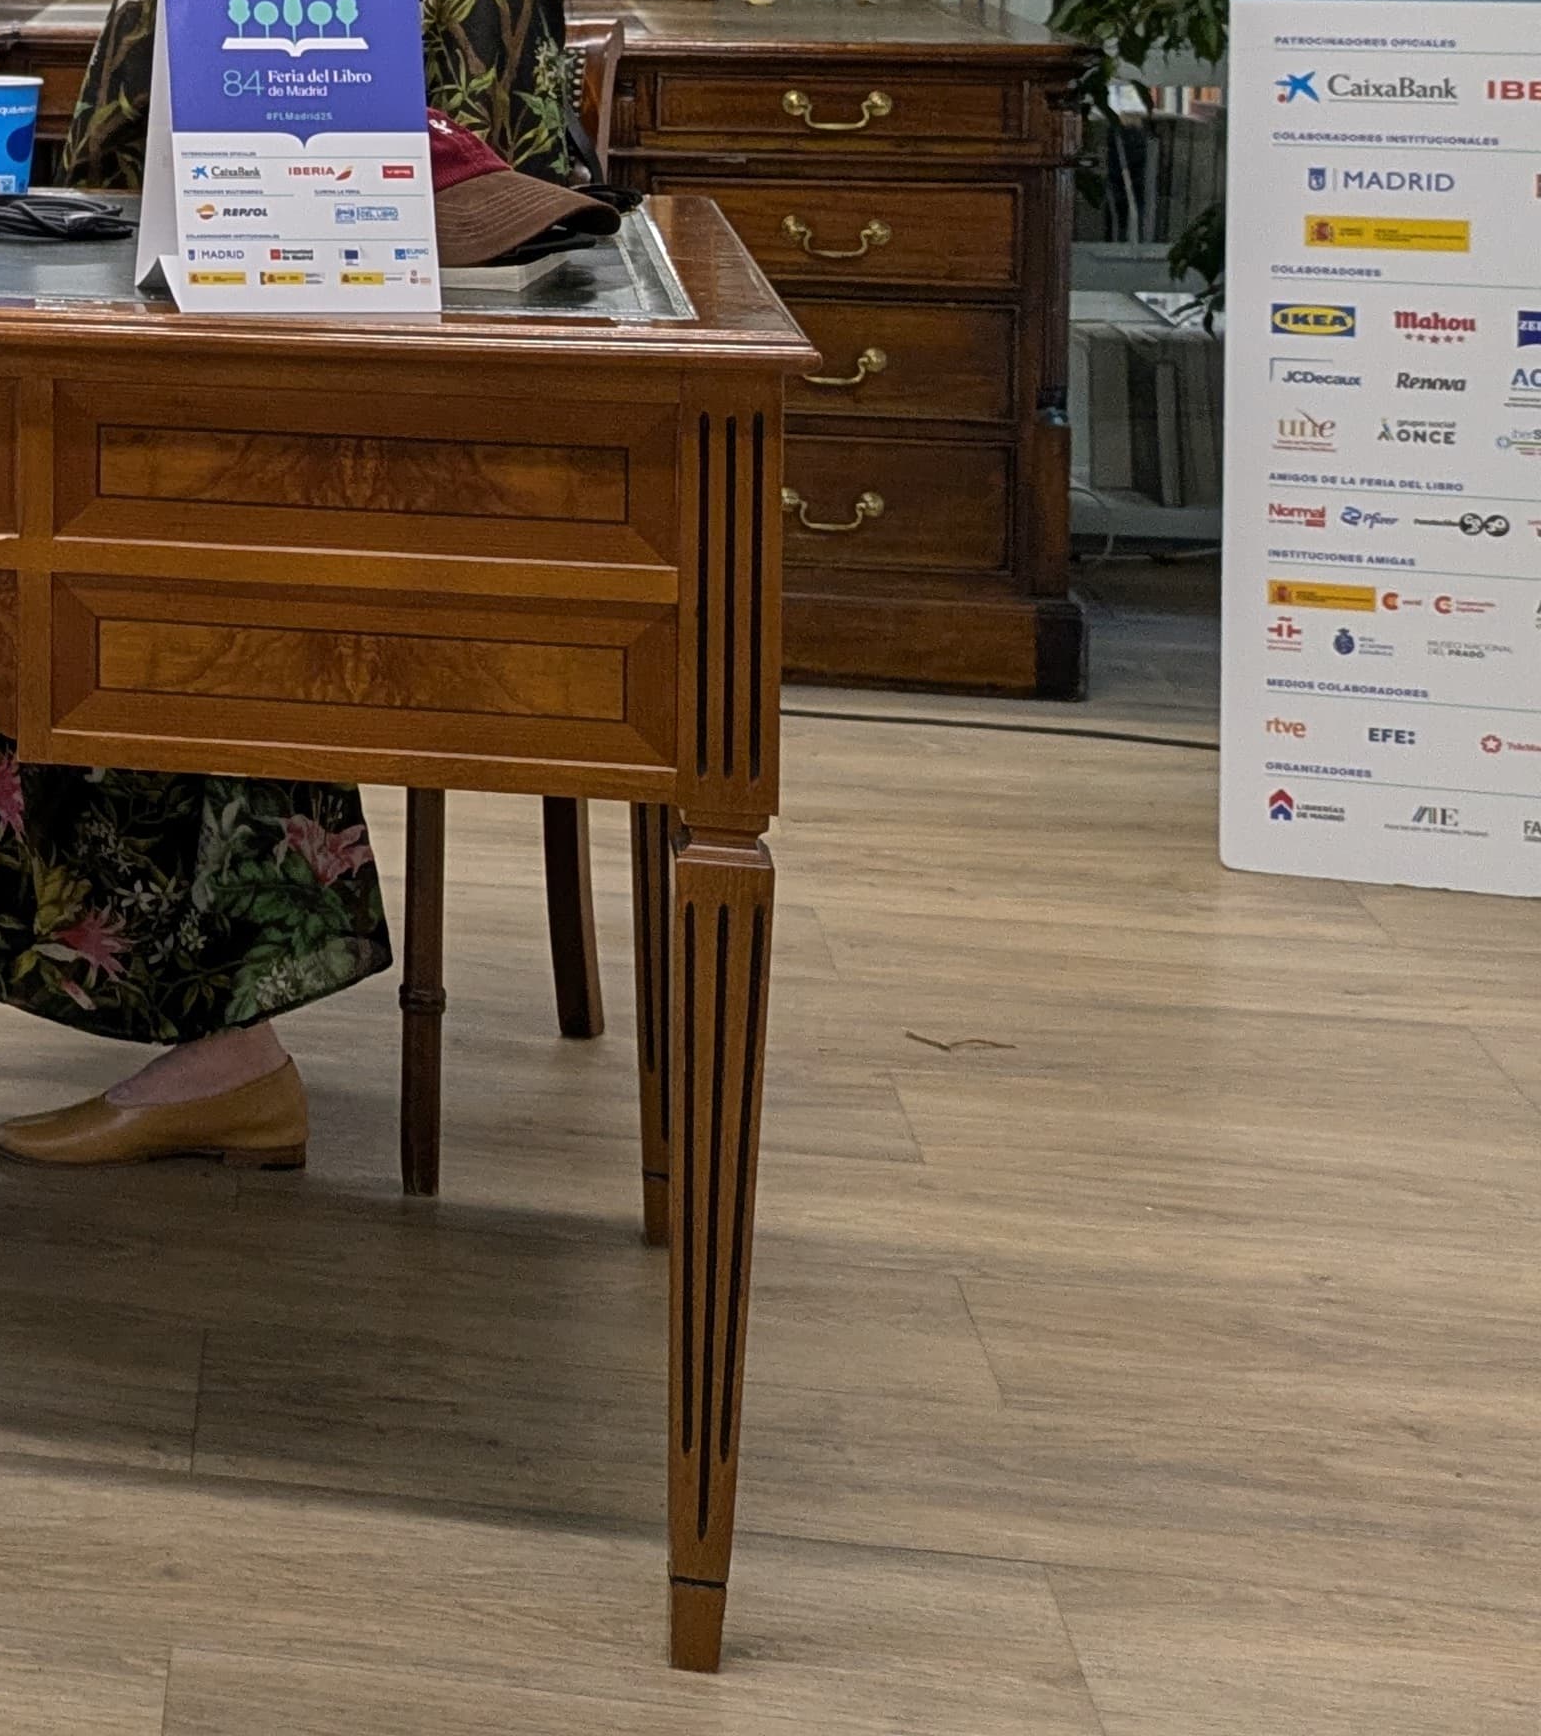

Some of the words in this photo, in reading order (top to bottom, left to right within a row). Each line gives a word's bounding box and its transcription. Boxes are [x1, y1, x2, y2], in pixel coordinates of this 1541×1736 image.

[223, 69, 265, 96] 84
[267, 69, 304, 83] Feria
[307, 69, 329, 83] del
[333, 69, 372, 83] Libro
[286, 85, 328, 96] Madrid
[1328, 74, 1457, 99] CaixaBank
[211, 166, 261, 177] CaixaBank
[288, 167, 335, 176] IBERIA
[1343, 171, 1455, 192] MADRID
[223, 208, 268, 217] REPSOL
[201, 249, 245, 260] MADRID
[1280, 313, 1348, 327] IKEA
[1394, 311, 1476, 332] Mahou
[1282, 370, 1362, 386] JCDecaux
[1396, 372, 1466, 391] Renova
[1278, 413, 1336, 439] une
[1397, 430, 1456, 444] ONCE
[1266, 717, 1306, 738] rtve
